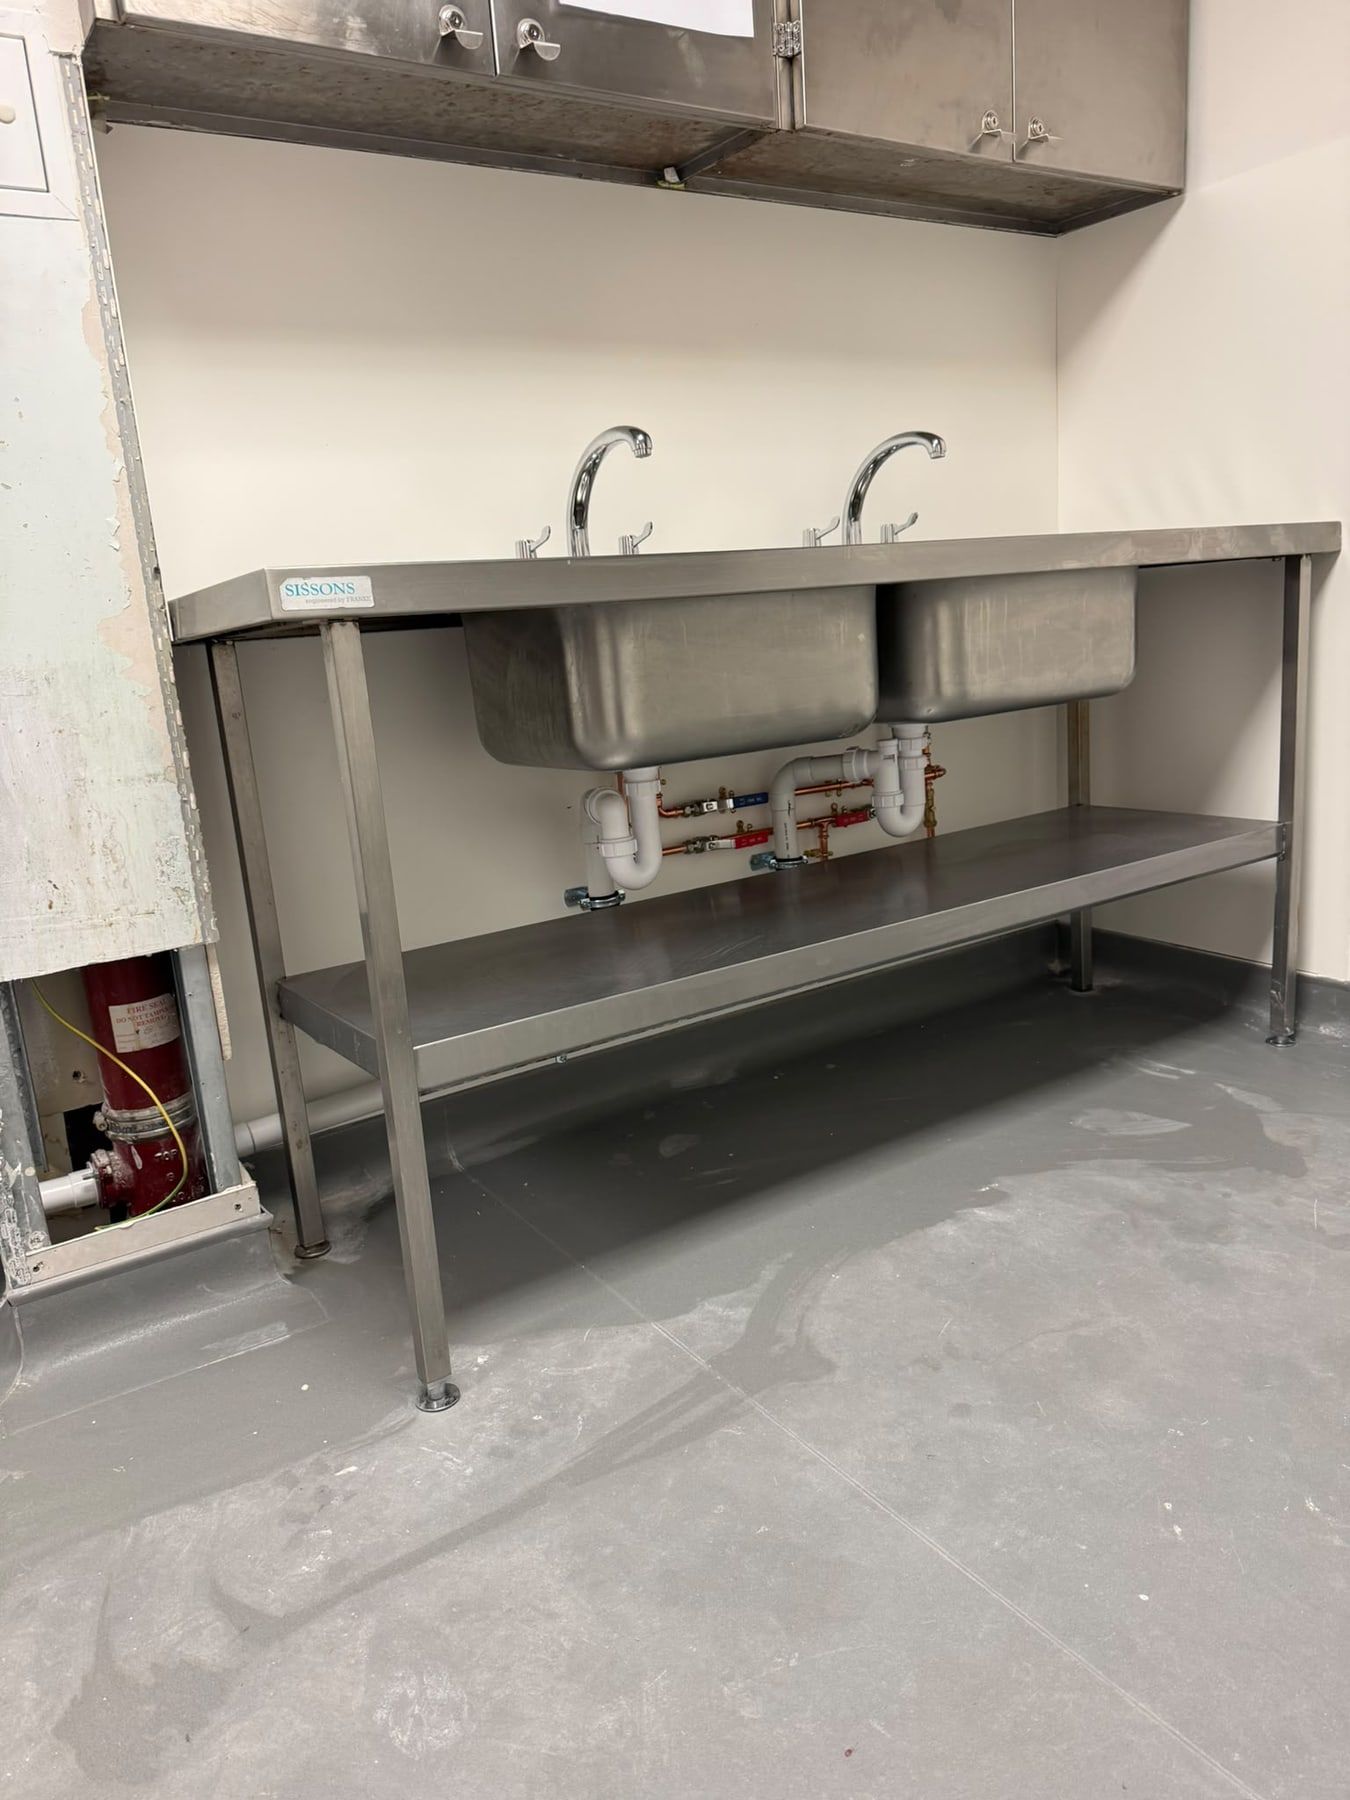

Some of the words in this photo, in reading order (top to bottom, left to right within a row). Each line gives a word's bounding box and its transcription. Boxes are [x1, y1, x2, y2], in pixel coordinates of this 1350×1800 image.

[285, 583, 355, 597] SISSONS
[128, 1006, 145, 1014] FIRE
[115, 1016, 127, 1024] DO
